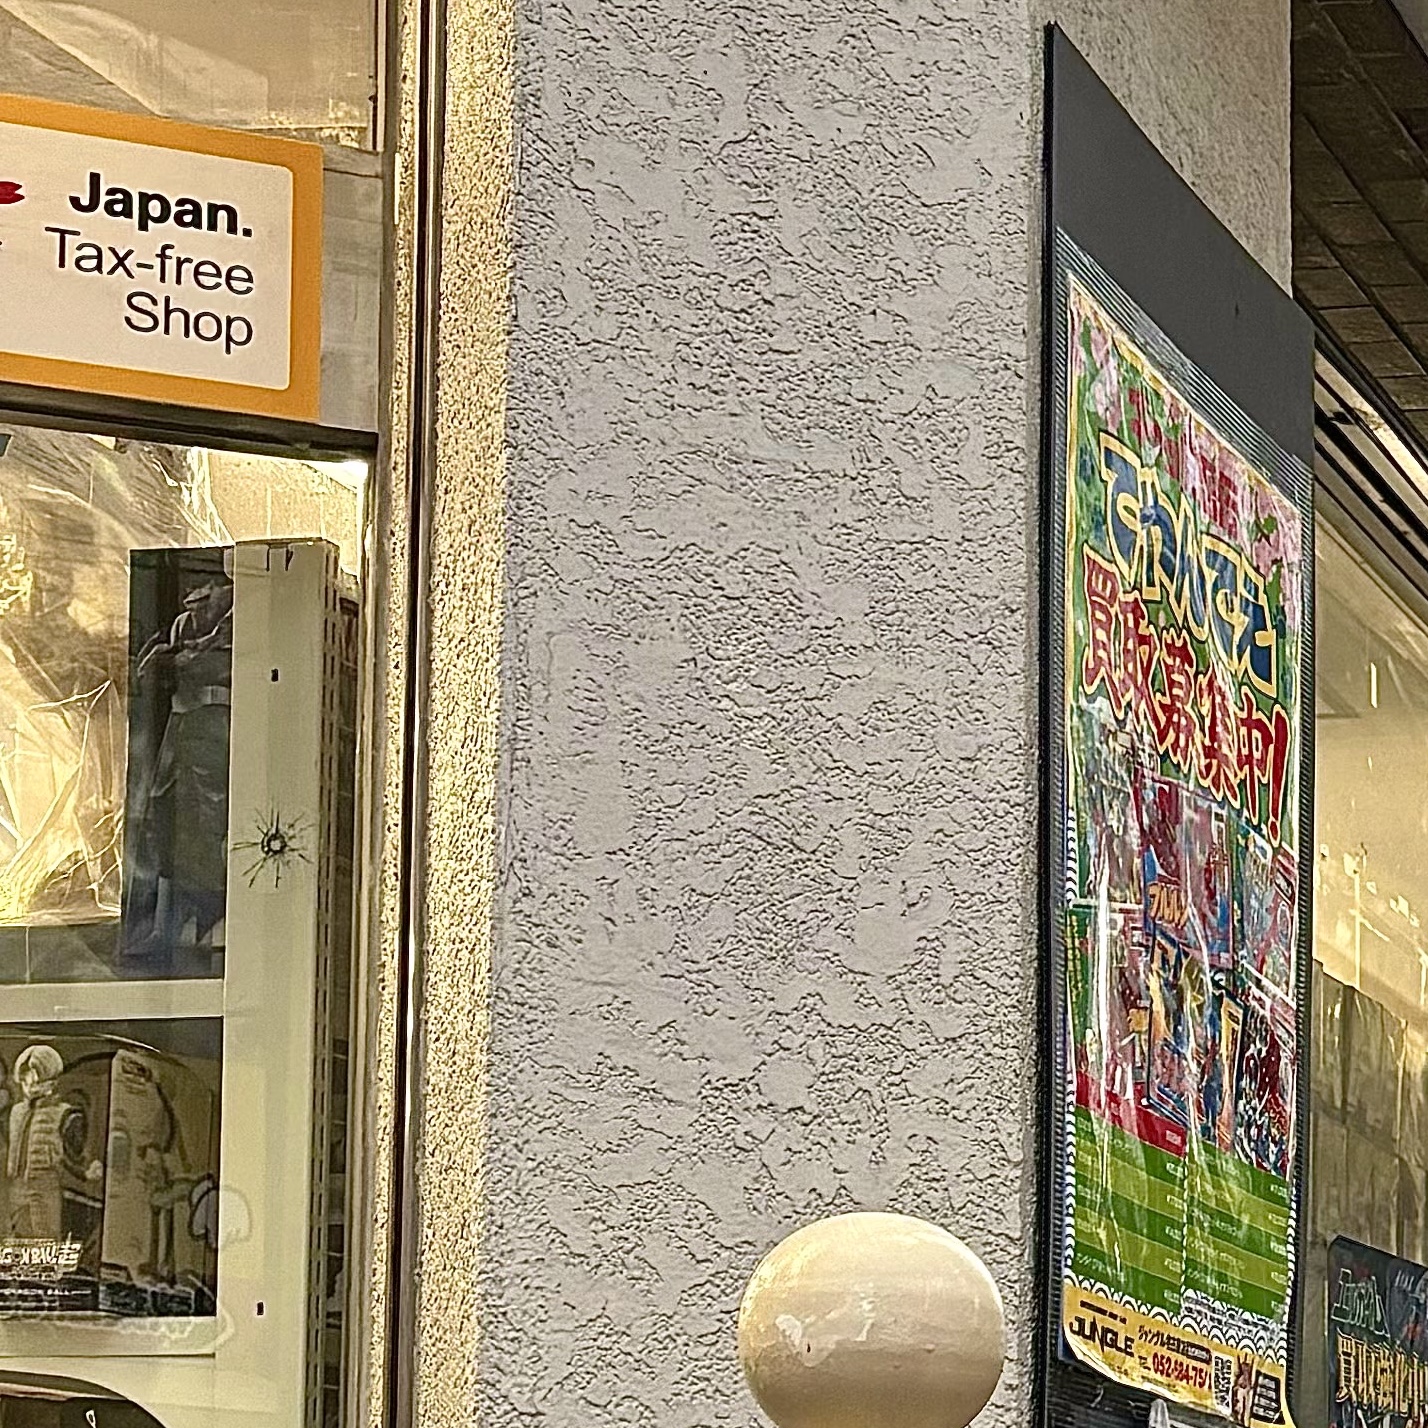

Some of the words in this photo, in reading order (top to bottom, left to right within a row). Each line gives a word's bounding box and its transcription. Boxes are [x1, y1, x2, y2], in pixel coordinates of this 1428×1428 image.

[68, 172, 254, 238] Japan.
[45, 226, 255, 296] Tax-free
[123, 292, 254, 354] Shop
[1069, 1312, 1134, 1357] JUNGLE
